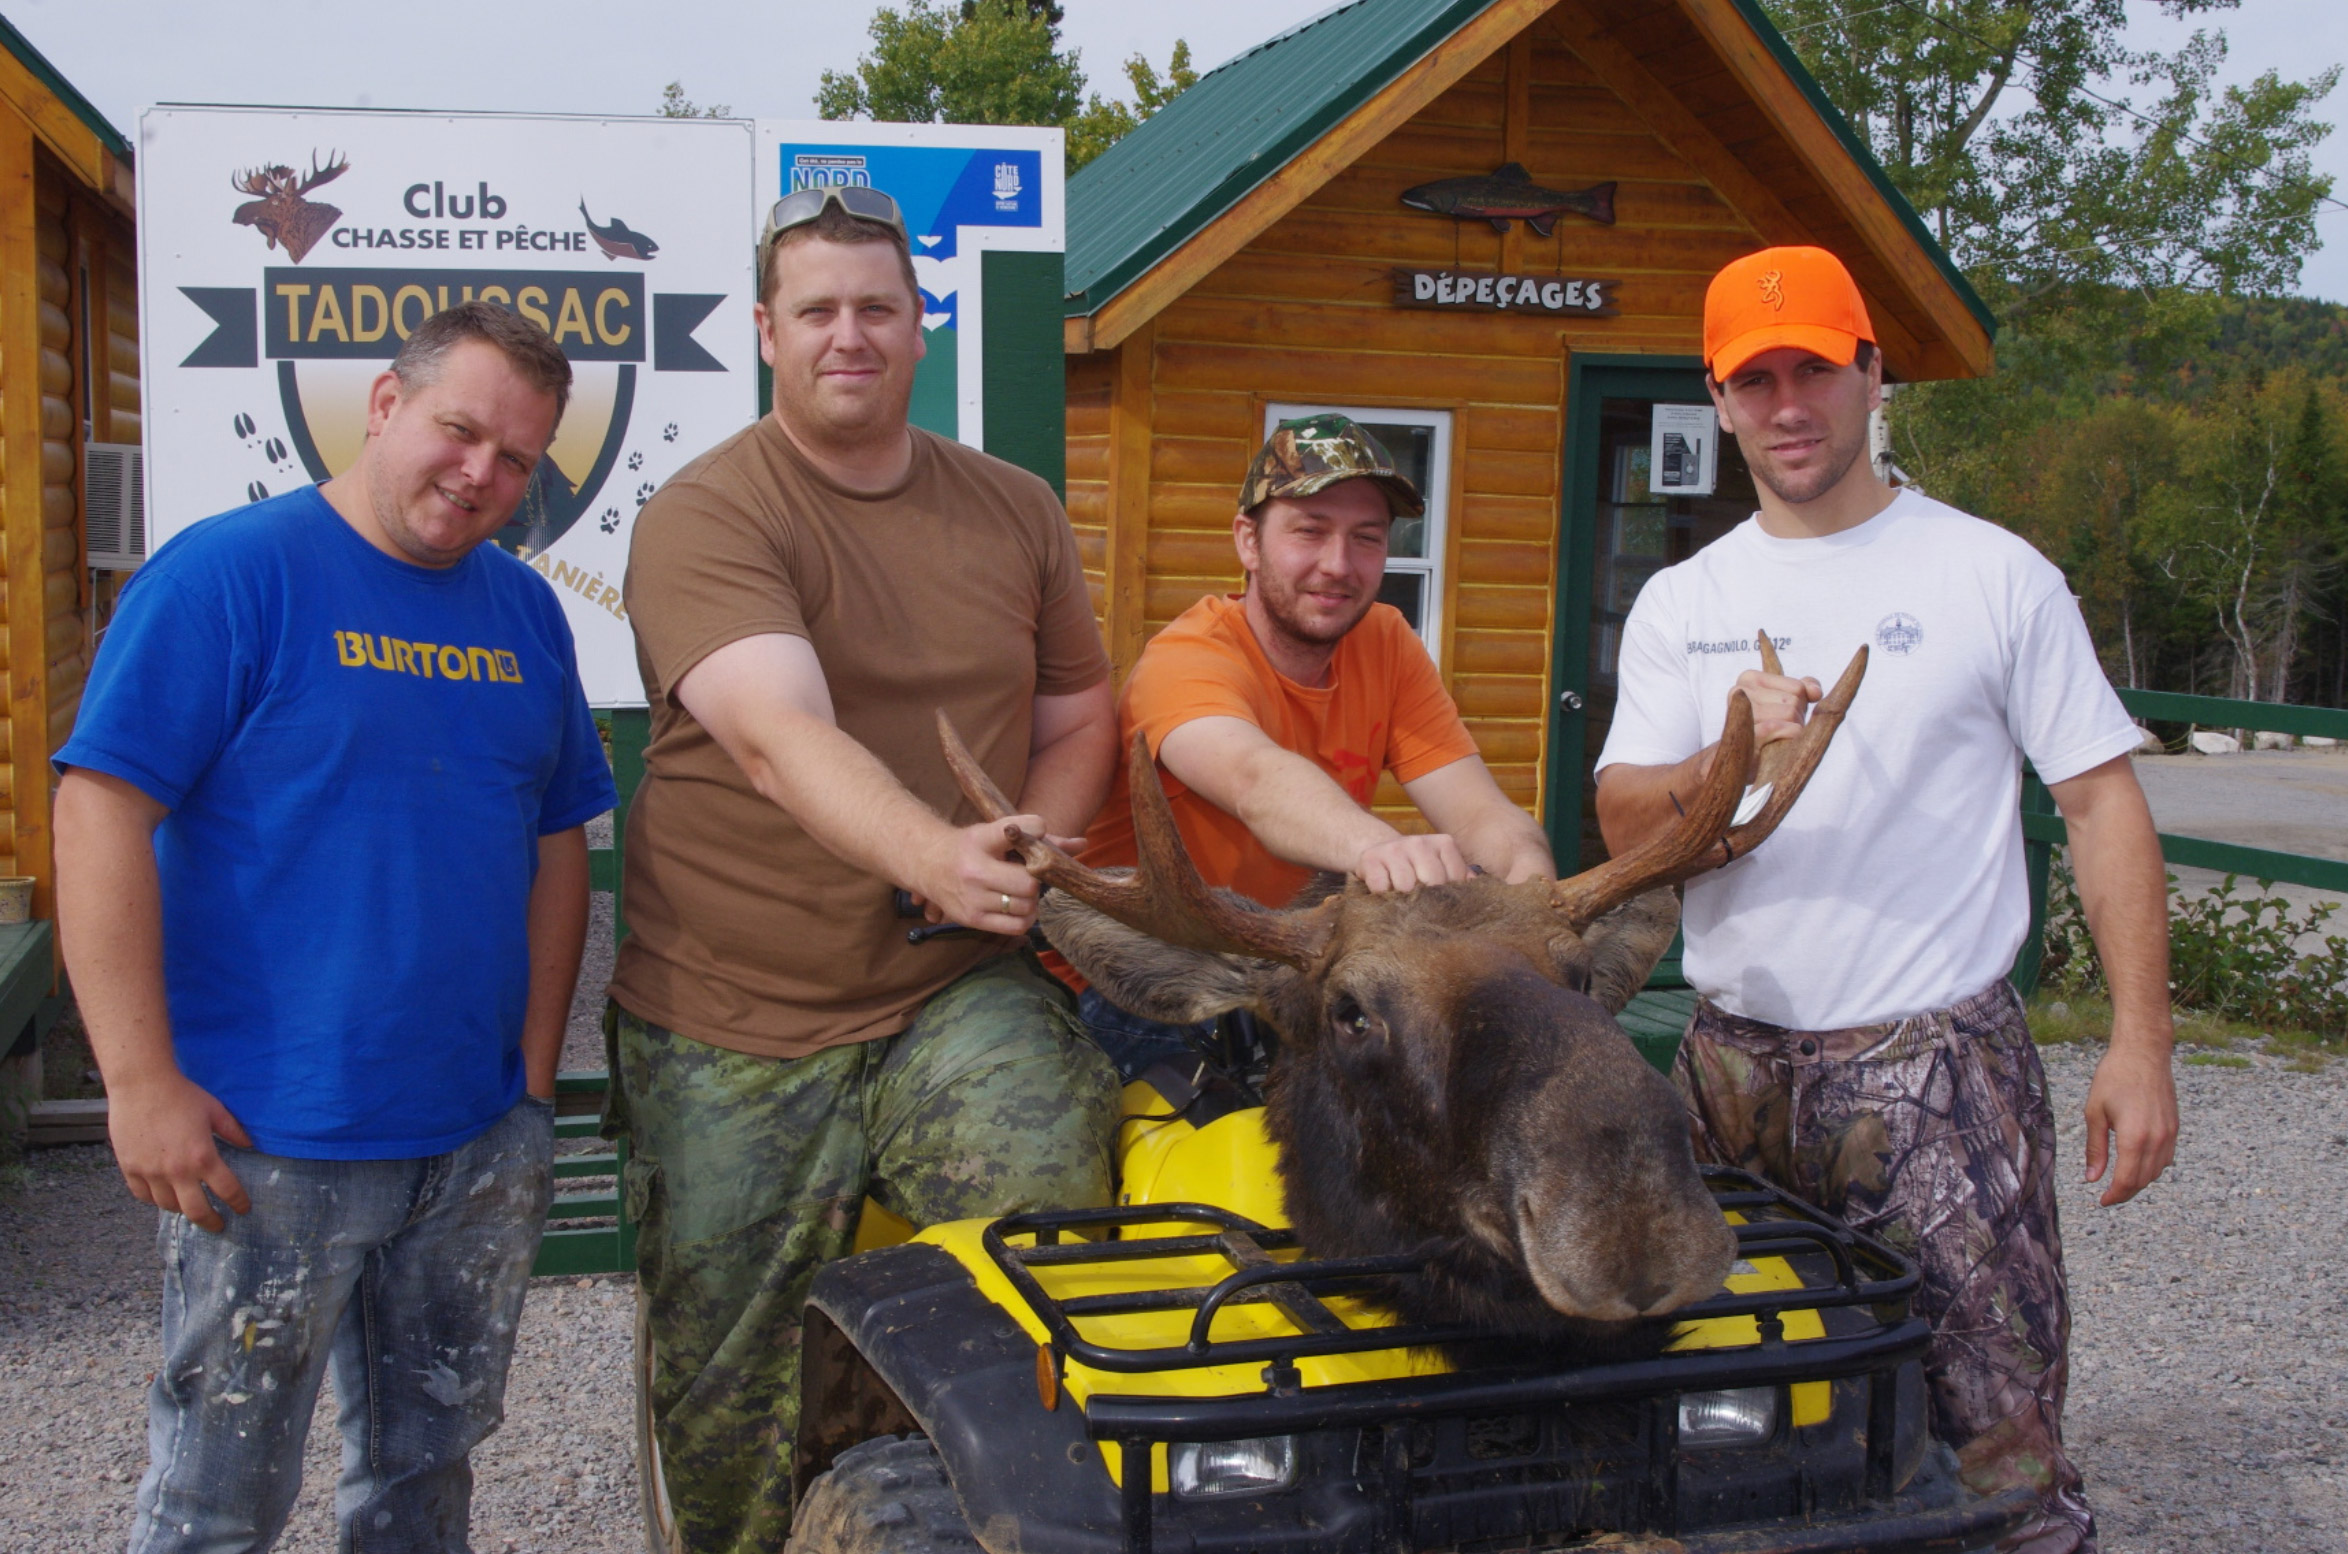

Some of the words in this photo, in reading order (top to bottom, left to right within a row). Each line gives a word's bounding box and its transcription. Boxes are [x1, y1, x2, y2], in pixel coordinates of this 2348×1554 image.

[403, 180, 507, 220] Club
[331, 227, 449, 249] CHASSE
[459, 230, 488, 249] ET
[496, 224, 586, 251] PÊCHE
[1414, 271, 1602, 310] DÉPEÇAGES
[333, 630, 499, 682] BURTON
